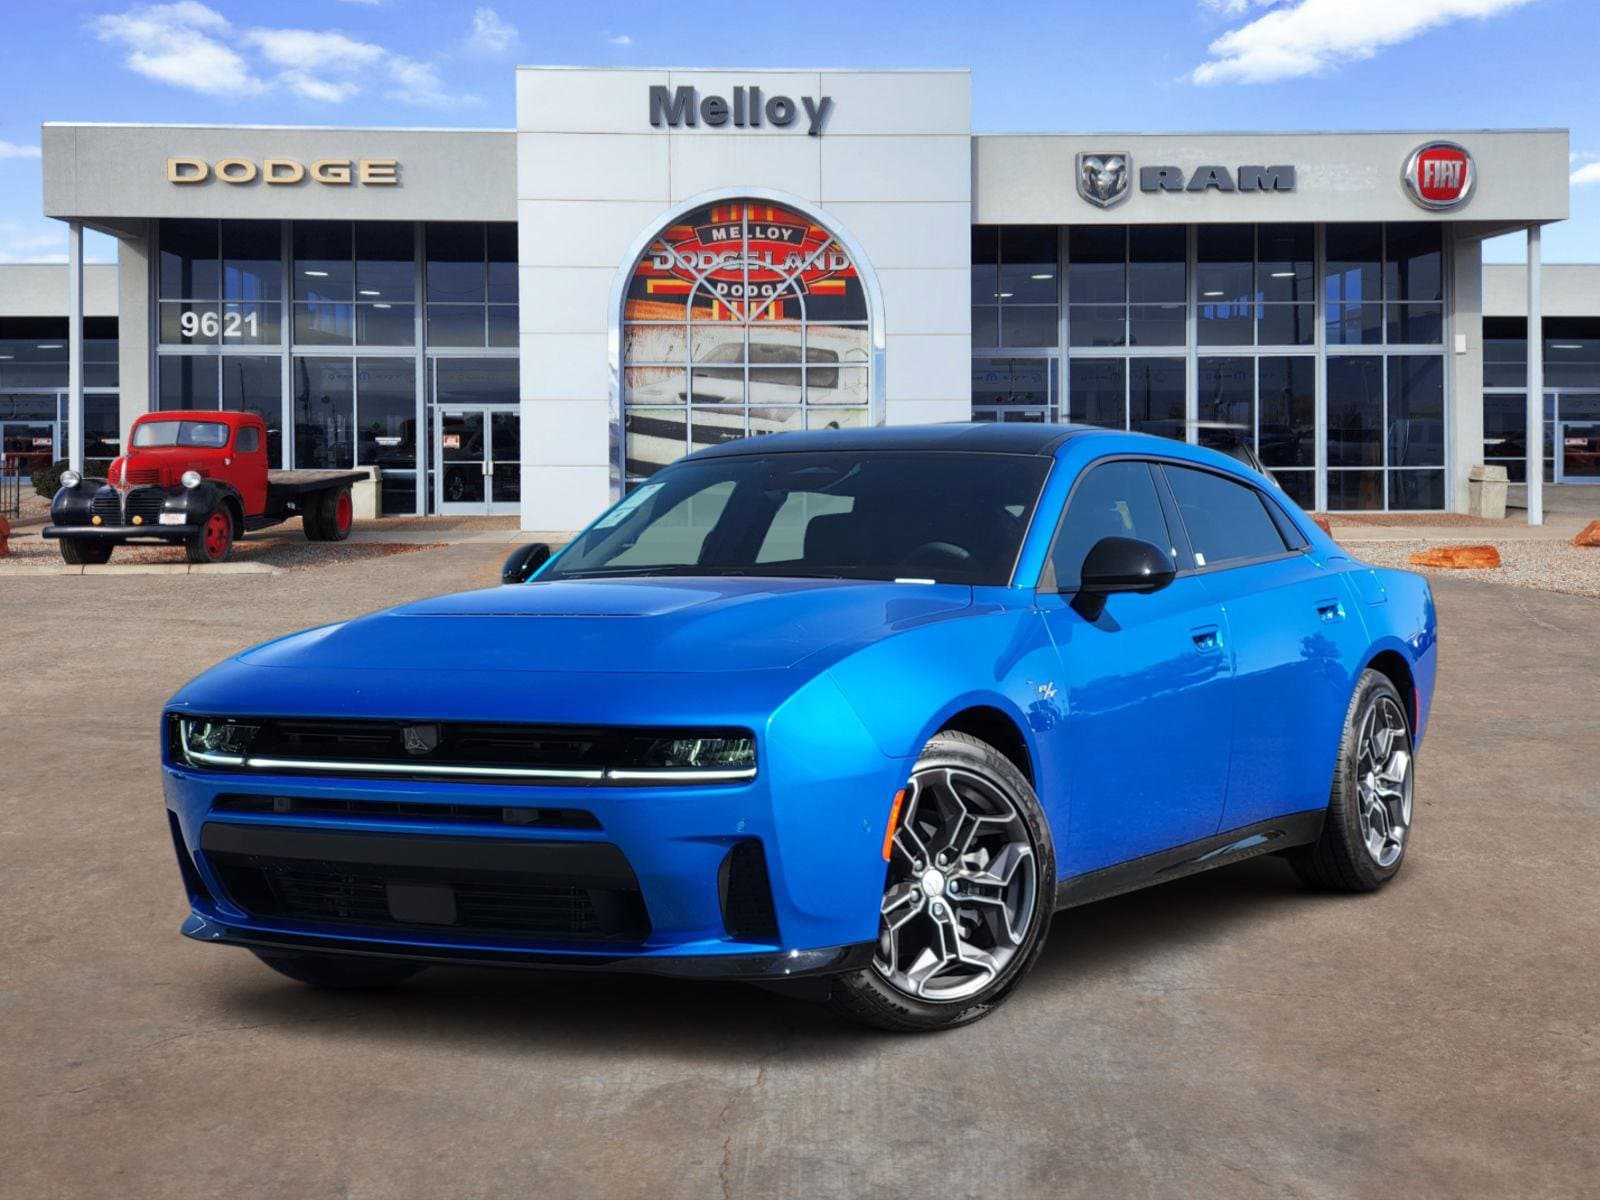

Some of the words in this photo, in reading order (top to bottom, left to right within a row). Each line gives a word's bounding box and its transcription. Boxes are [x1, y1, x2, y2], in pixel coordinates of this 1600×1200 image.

[649, 85, 832, 136] Melloy
[166, 157, 398, 185] DODGE
[1139, 165, 1296, 192] RAM
[1423, 158, 1463, 188] FIAT
[711, 225, 793, 241] MELOY
[181, 311, 258, 337] 9621
